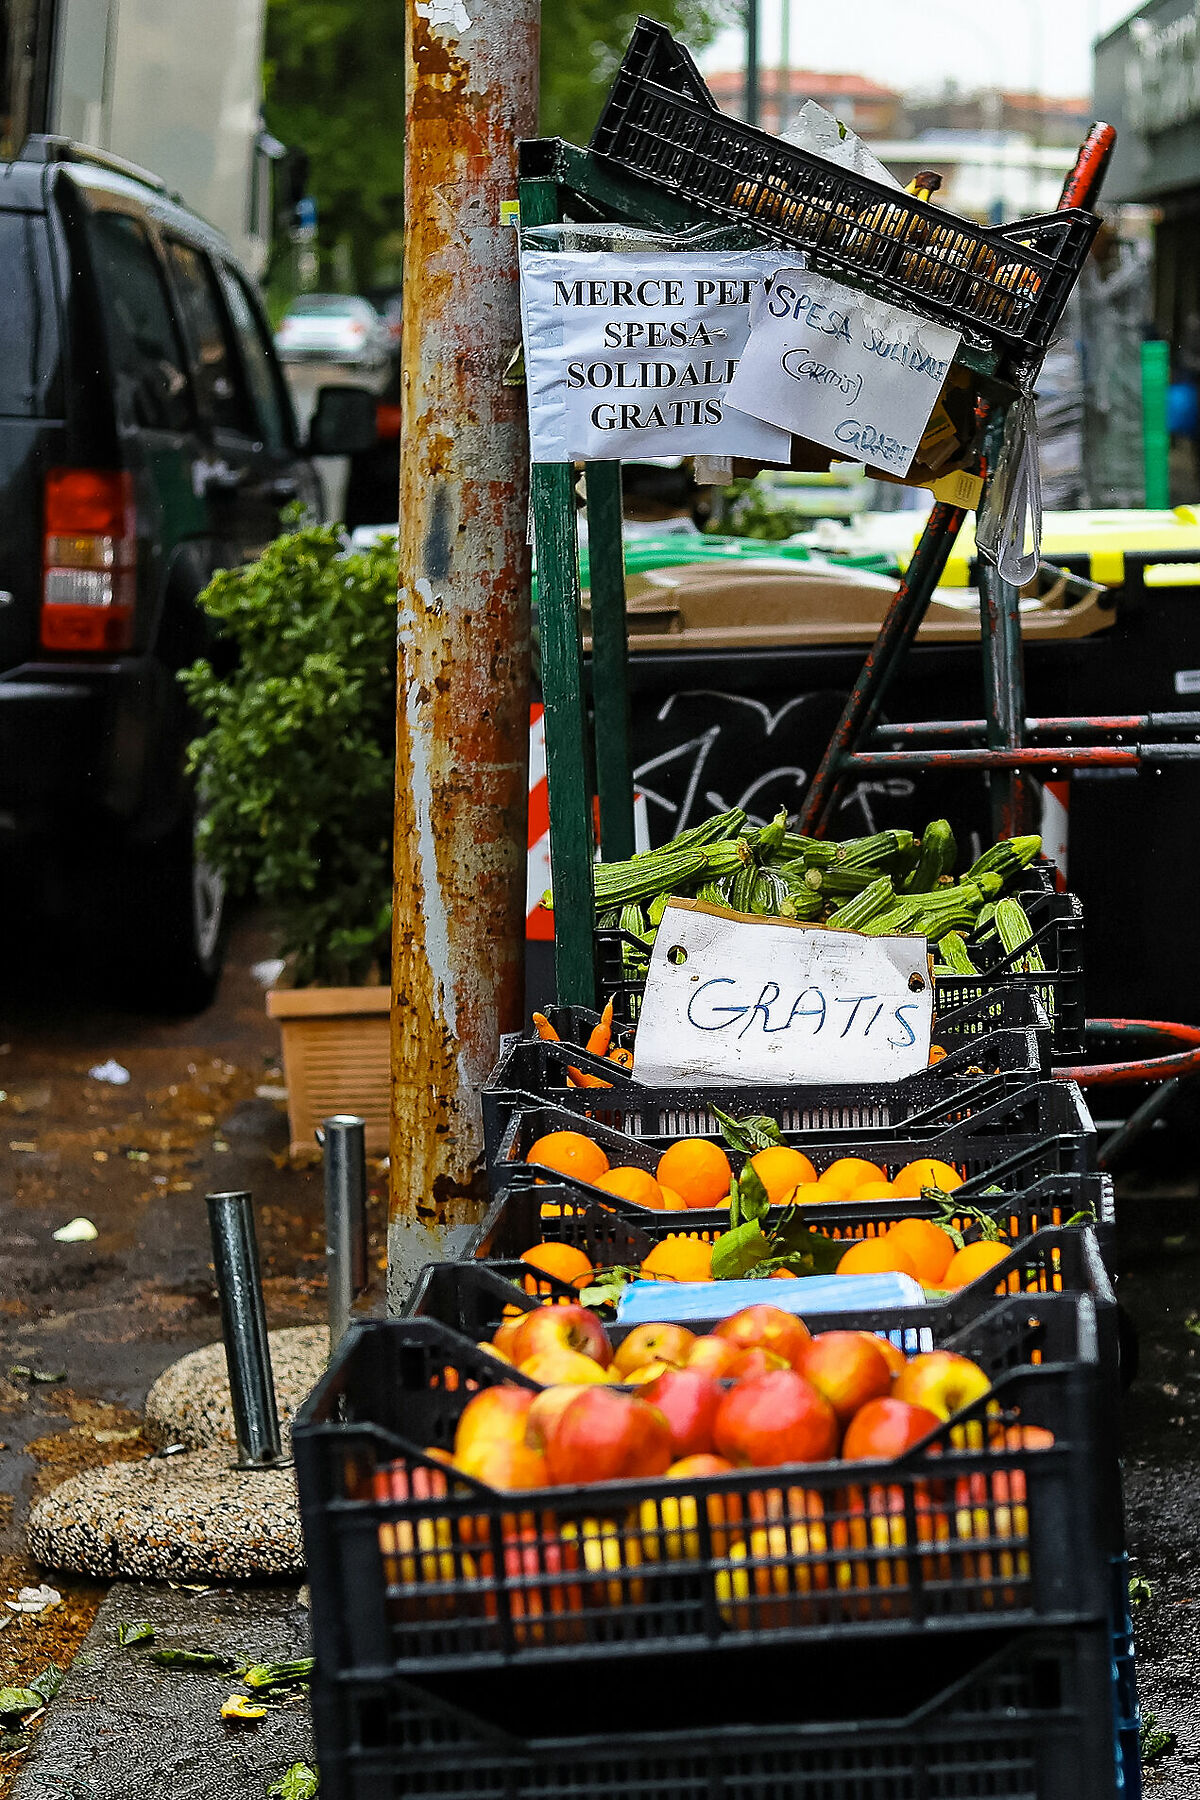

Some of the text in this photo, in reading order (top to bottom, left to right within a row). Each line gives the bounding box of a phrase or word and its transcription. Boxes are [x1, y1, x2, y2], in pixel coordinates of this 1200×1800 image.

[552, 279, 685, 307] MERCE
[768, 284, 853, 344] SPESA
[603, 321, 714, 348] SPESA
[590, 398, 723, 430] GRATIS
[687, 977, 920, 1048] GRATIS
